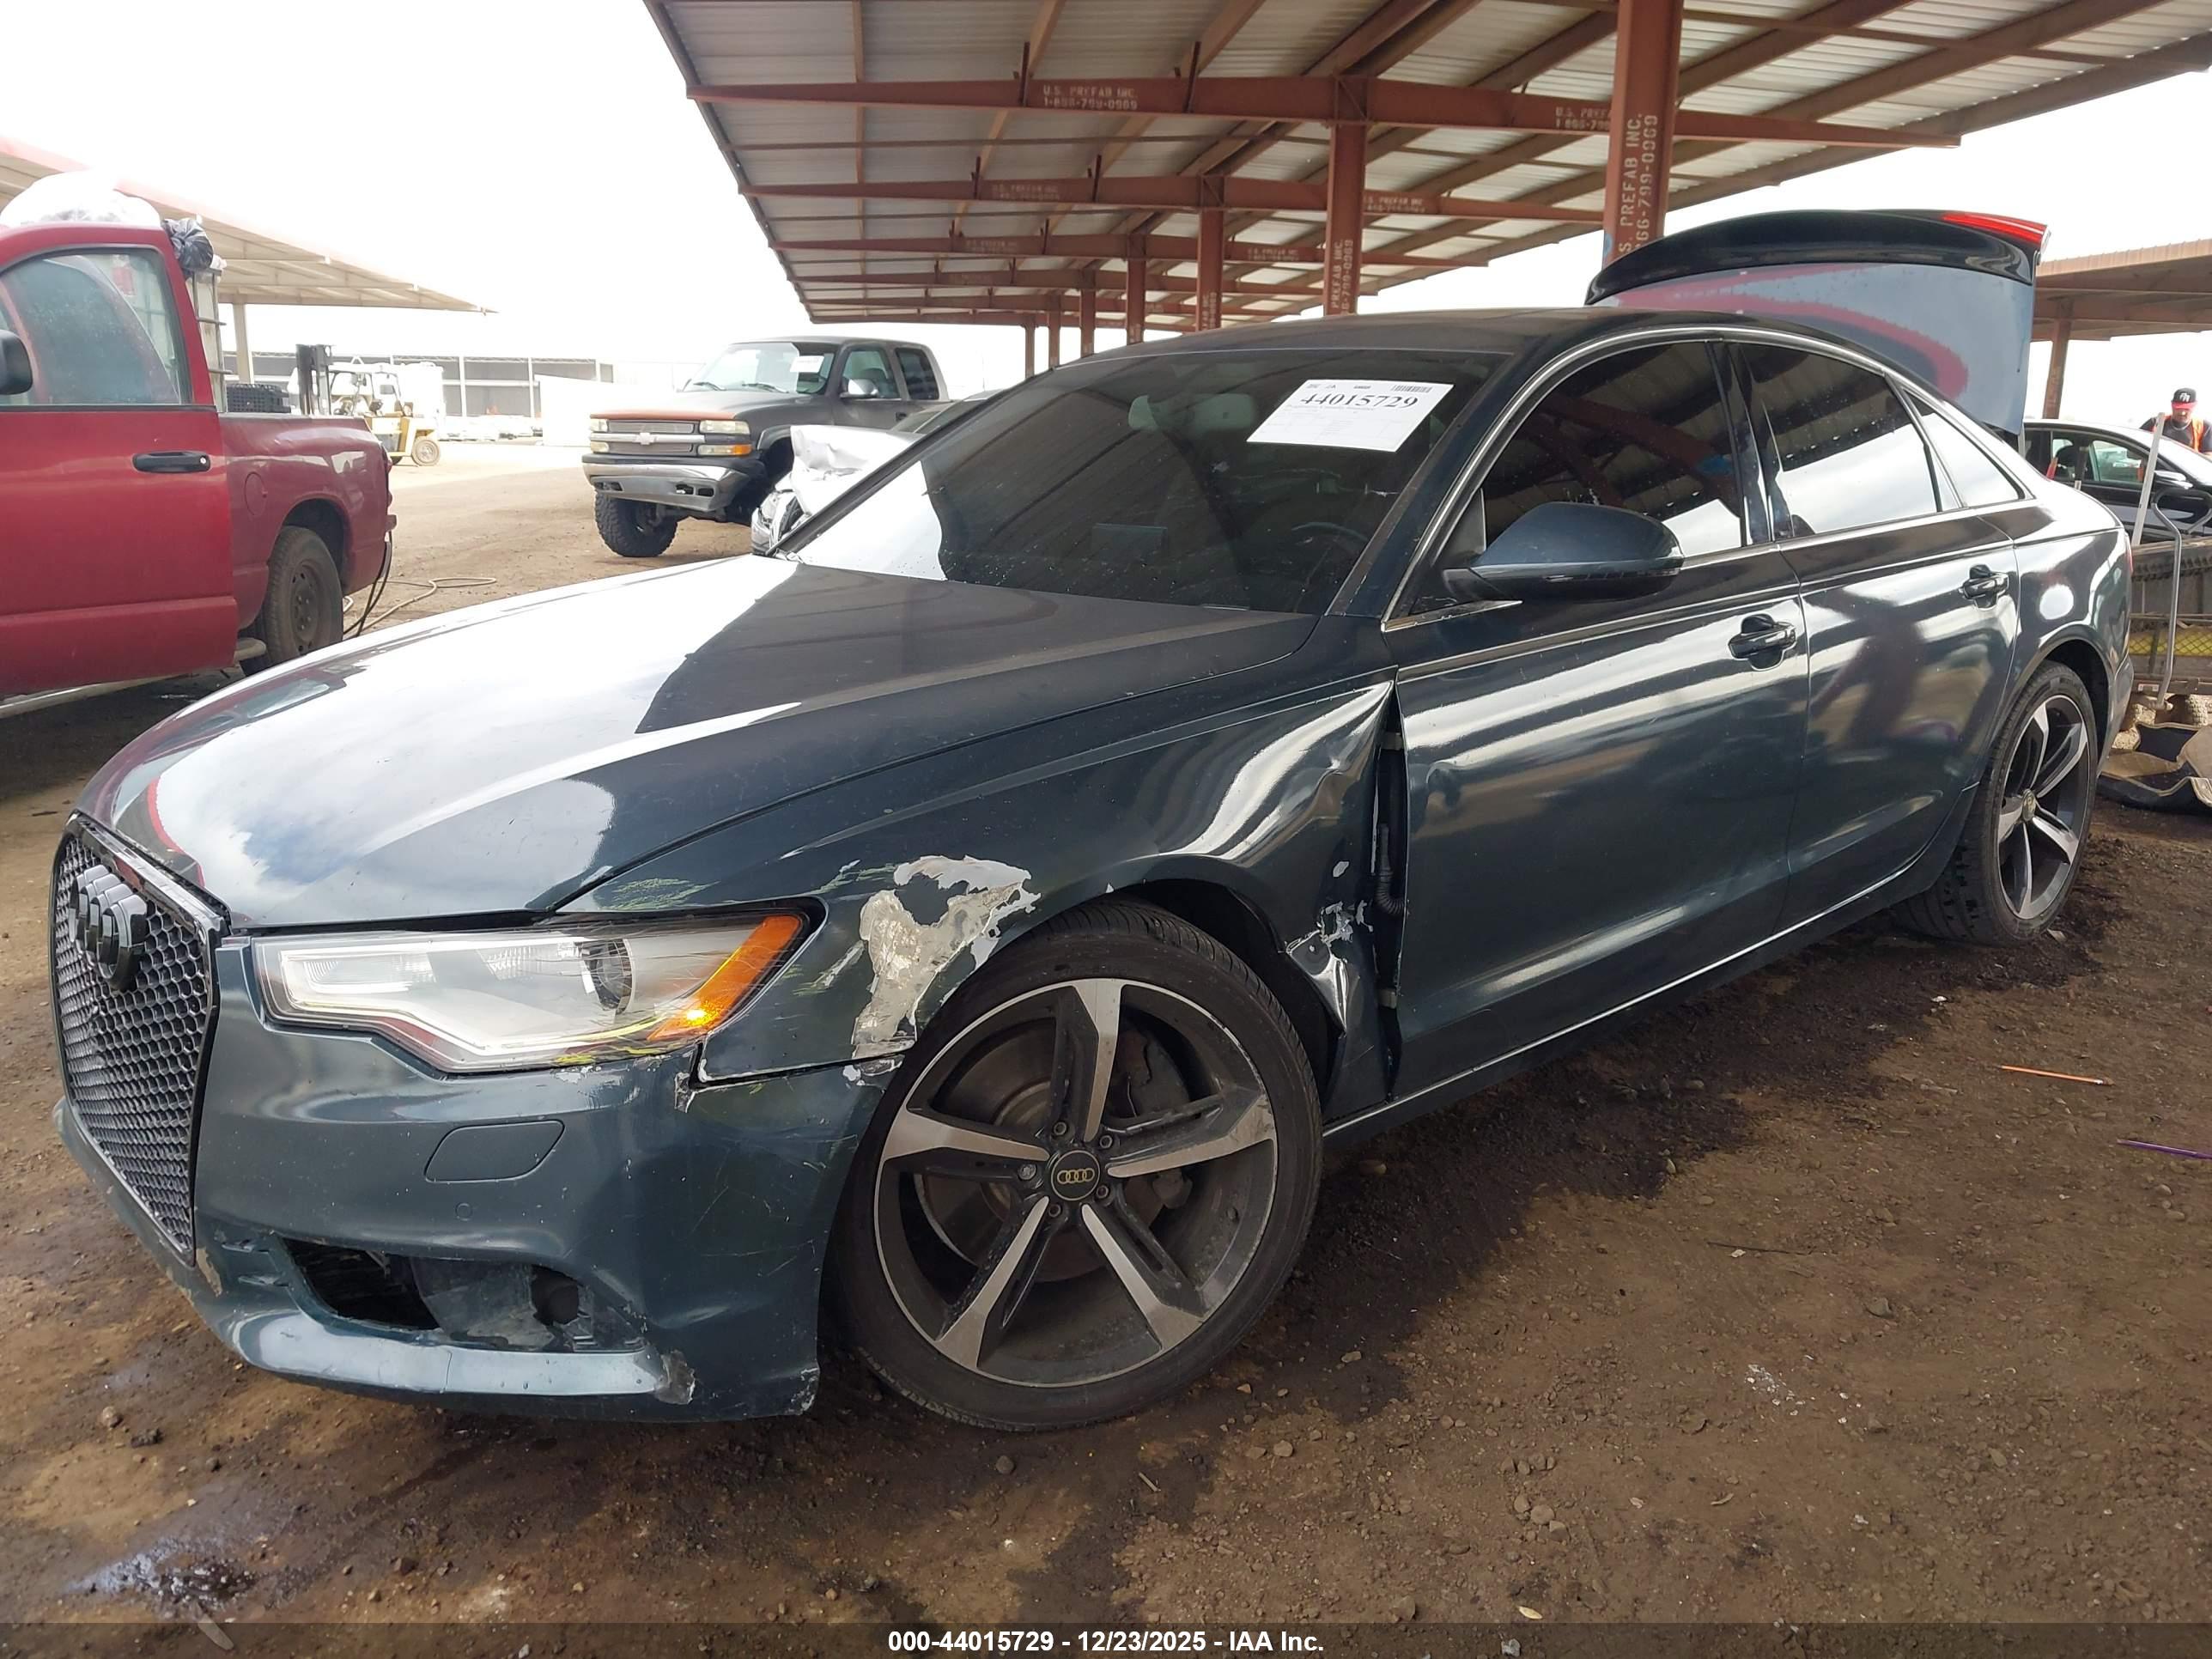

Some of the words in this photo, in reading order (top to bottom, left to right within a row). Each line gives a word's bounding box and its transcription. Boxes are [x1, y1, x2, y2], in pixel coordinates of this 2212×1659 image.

[1626, 112, 1644, 148] INC.
[1620, 156, 1638, 227] PREFAB
[1301, 393, 1419, 409] 44015729
